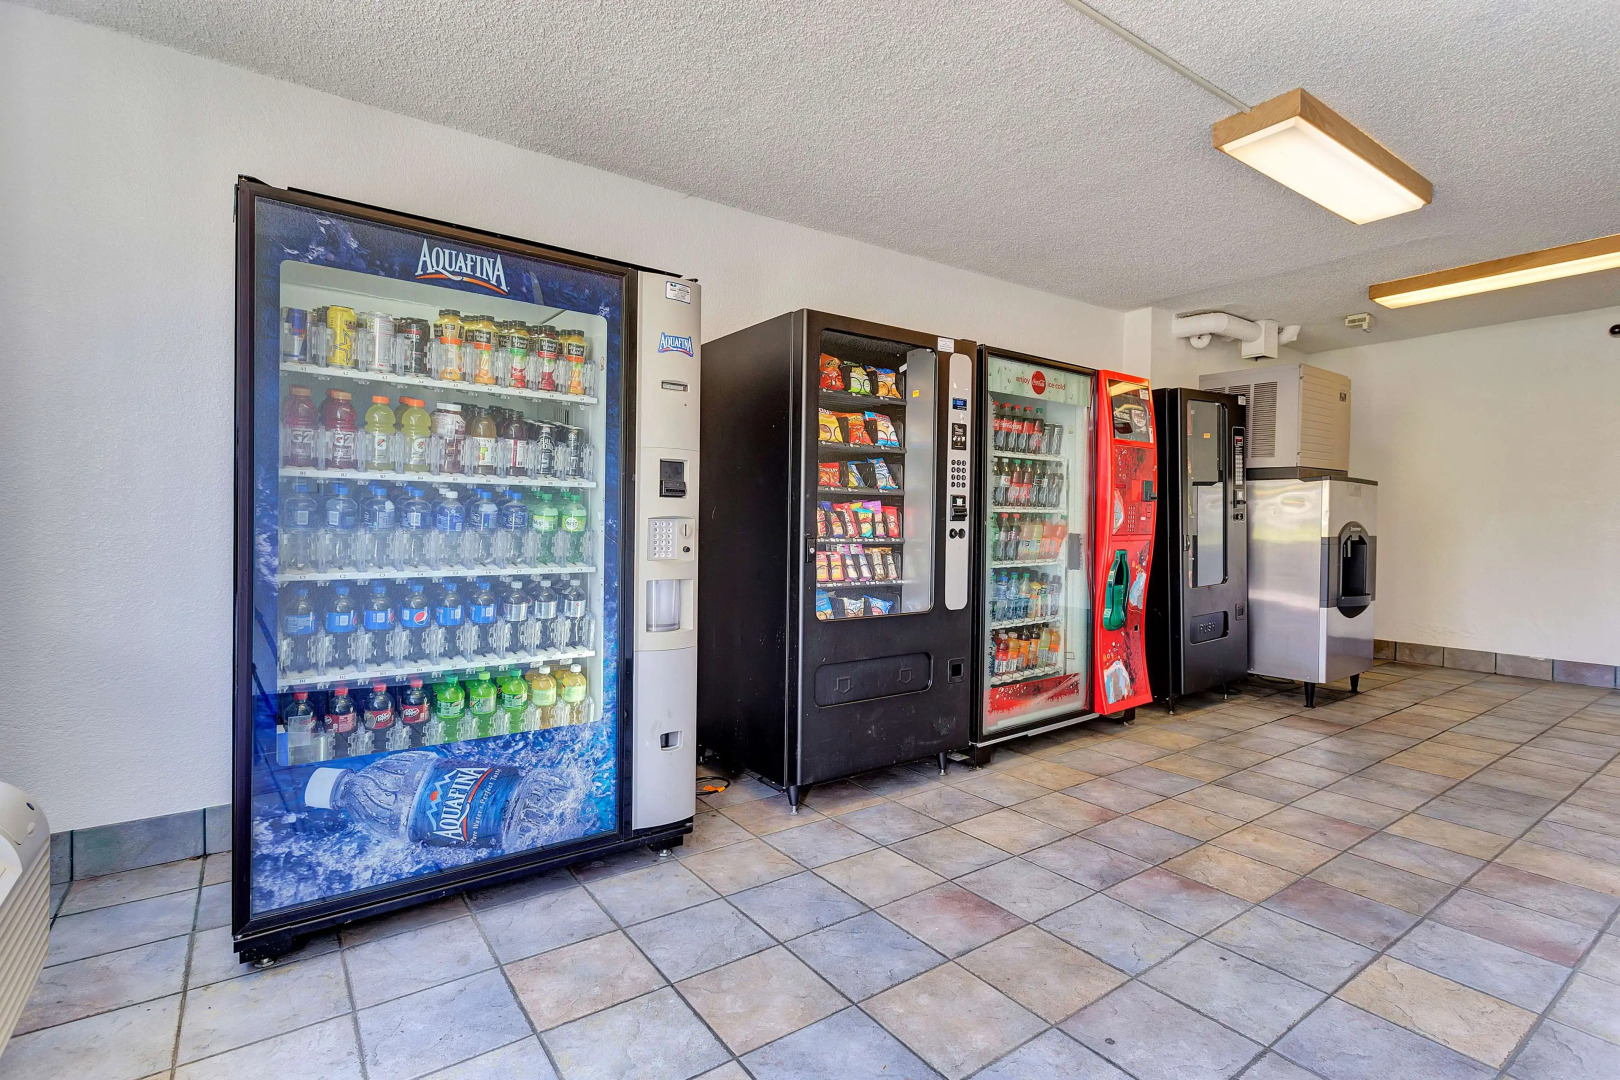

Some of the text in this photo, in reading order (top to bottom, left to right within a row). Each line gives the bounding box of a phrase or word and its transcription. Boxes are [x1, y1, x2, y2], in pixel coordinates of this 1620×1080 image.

[415, 238, 509, 293] AQUAFINA
[659, 333, 694, 356] AQUAFINA
[1016, 376, 1030, 384] enjoy
[433, 767, 490, 842] AQUAFINA
[472, 811, 482, 829] Water
[480, 782, 494, 804] Perfect
